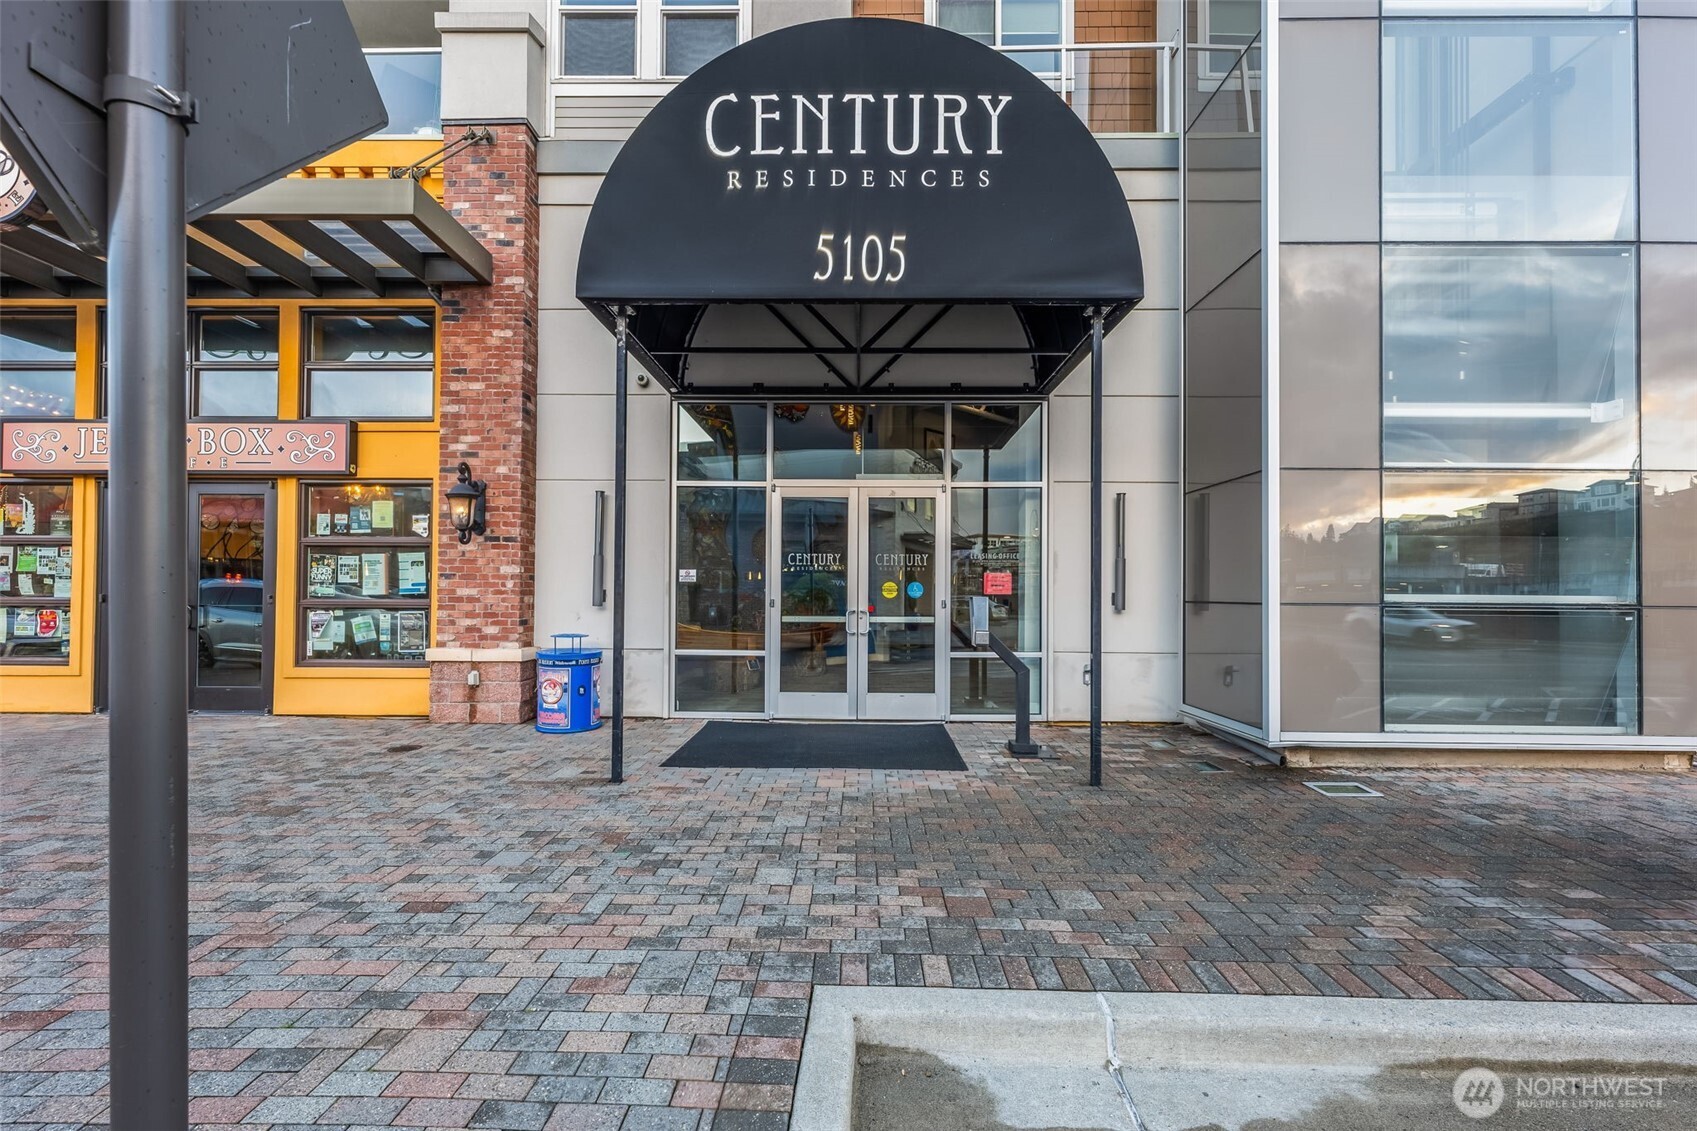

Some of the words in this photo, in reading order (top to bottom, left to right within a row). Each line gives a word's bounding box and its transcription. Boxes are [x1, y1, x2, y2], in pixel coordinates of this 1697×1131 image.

[705, 93, 1012, 157] CENTURY
[727, 169, 990, 189] RESIDENCES
[813, 234, 906, 282] 5105
[198, 427, 273, 455] BOX
[788, 553, 841, 565] CENTURY
[875, 553, 929, 566] CENTURY
